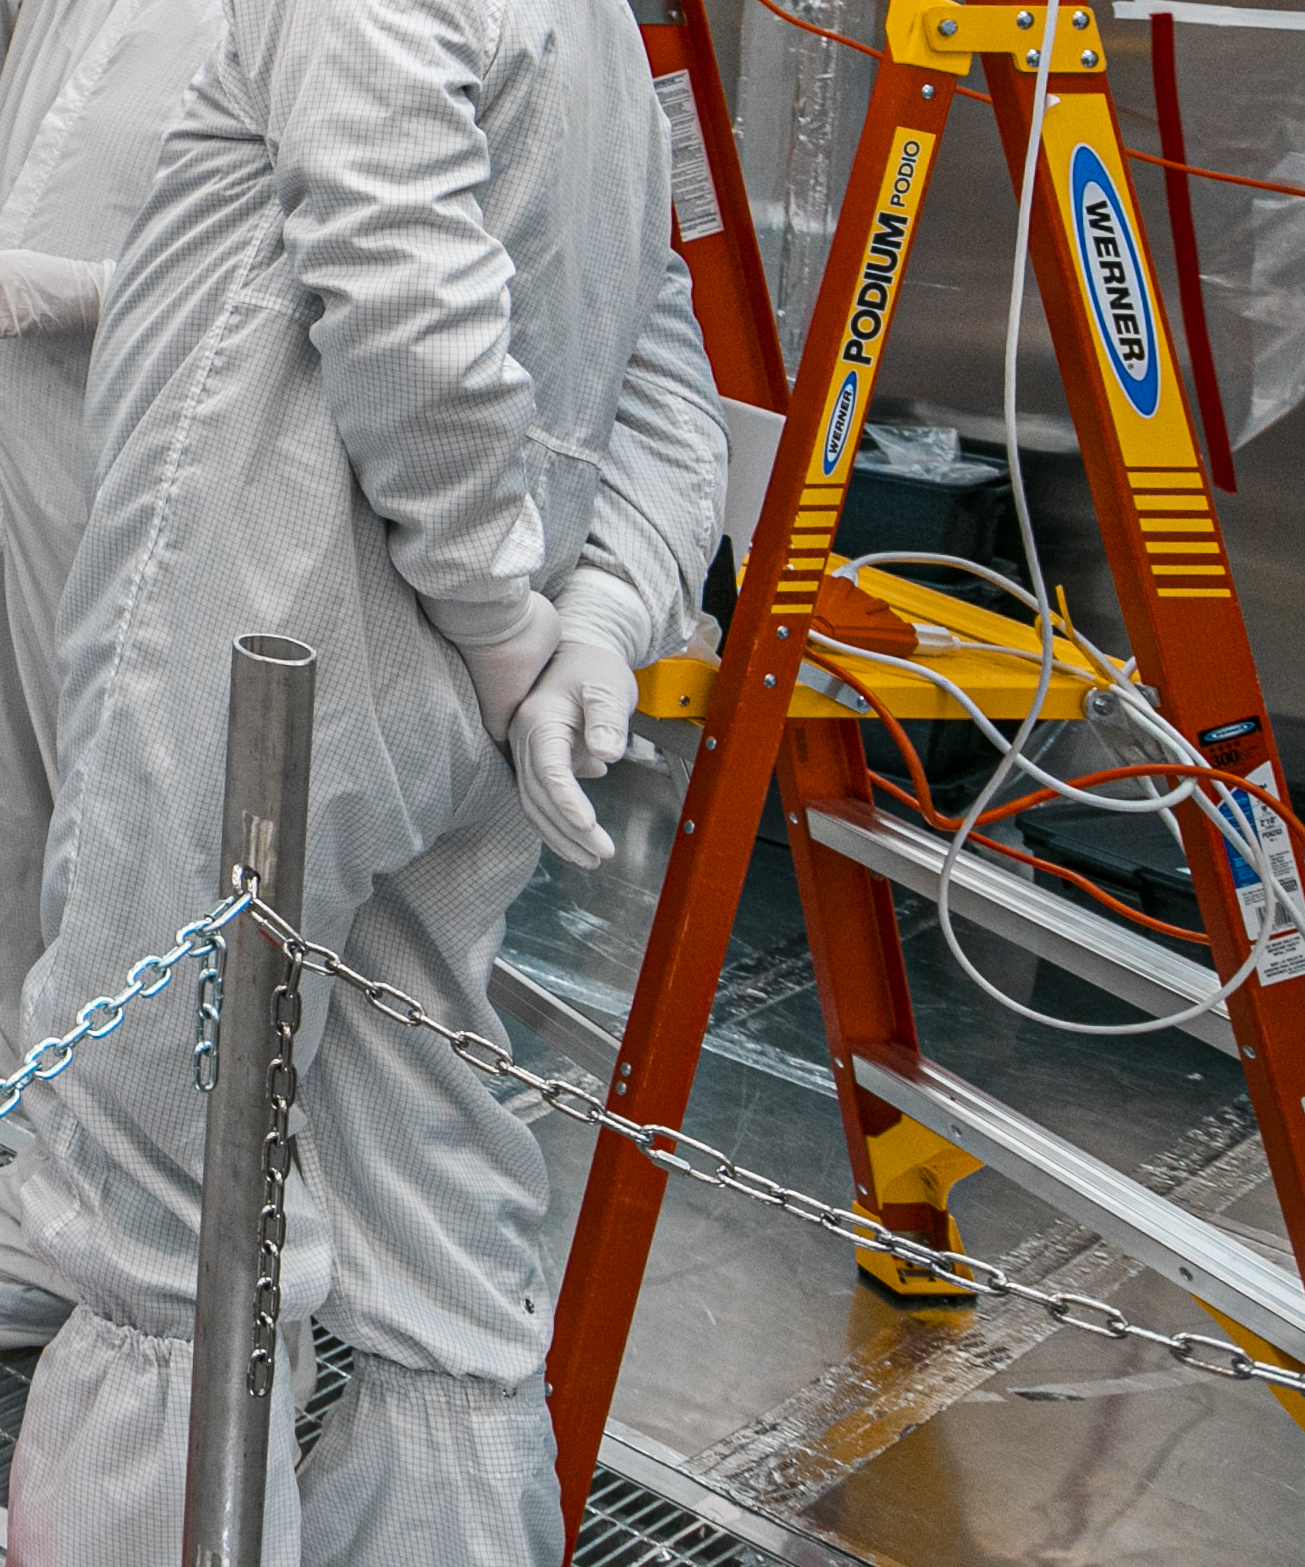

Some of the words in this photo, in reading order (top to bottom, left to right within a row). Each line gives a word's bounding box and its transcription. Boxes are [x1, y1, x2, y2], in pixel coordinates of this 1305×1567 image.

[827, 390, 852, 455] WERNER
[842, 212, 908, 366] PODIUM
[890, 140, 920, 208] PODIO
[1085, 200, 1146, 363] WERNER
